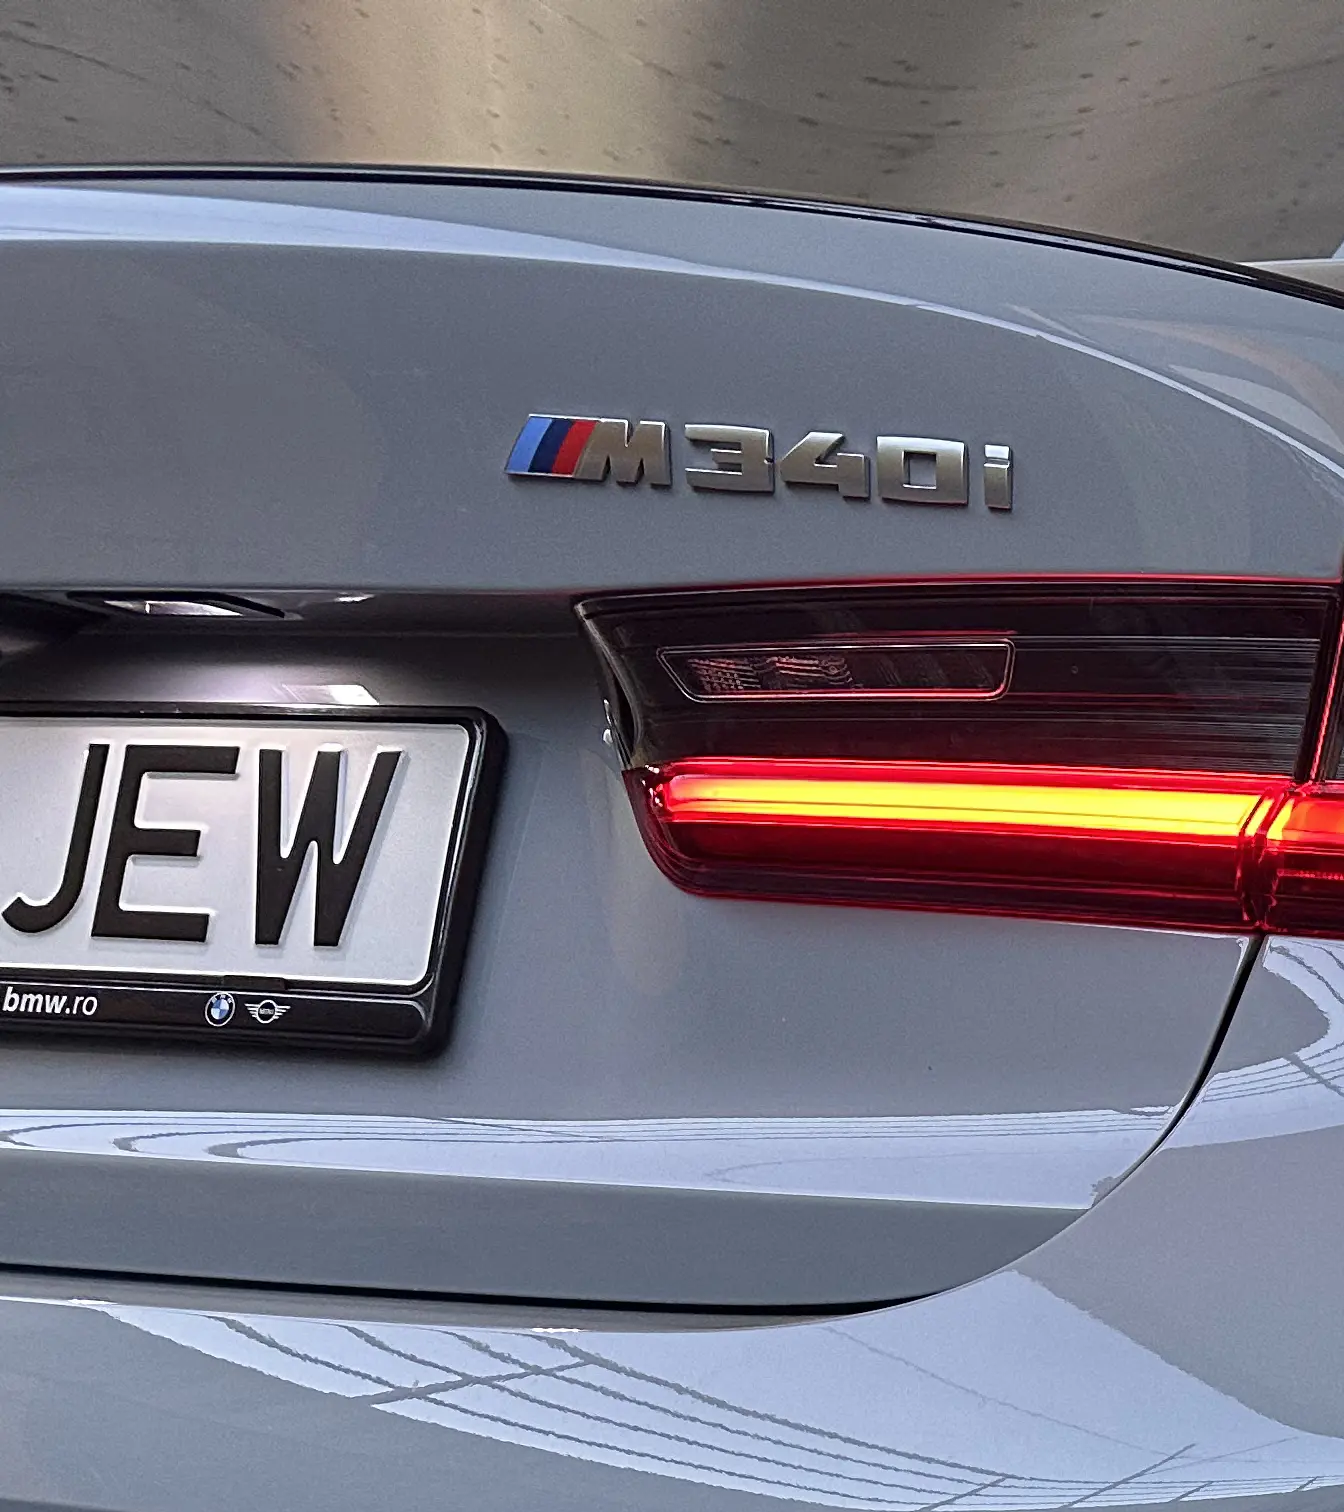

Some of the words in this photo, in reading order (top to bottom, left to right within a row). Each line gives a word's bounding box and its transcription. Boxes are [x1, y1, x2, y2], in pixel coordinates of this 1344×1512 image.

[573, 416, 1013, 510] M340i
[2, 743, 404, 947] JEW
[2, 986, 98, 1016] bmw.ro
